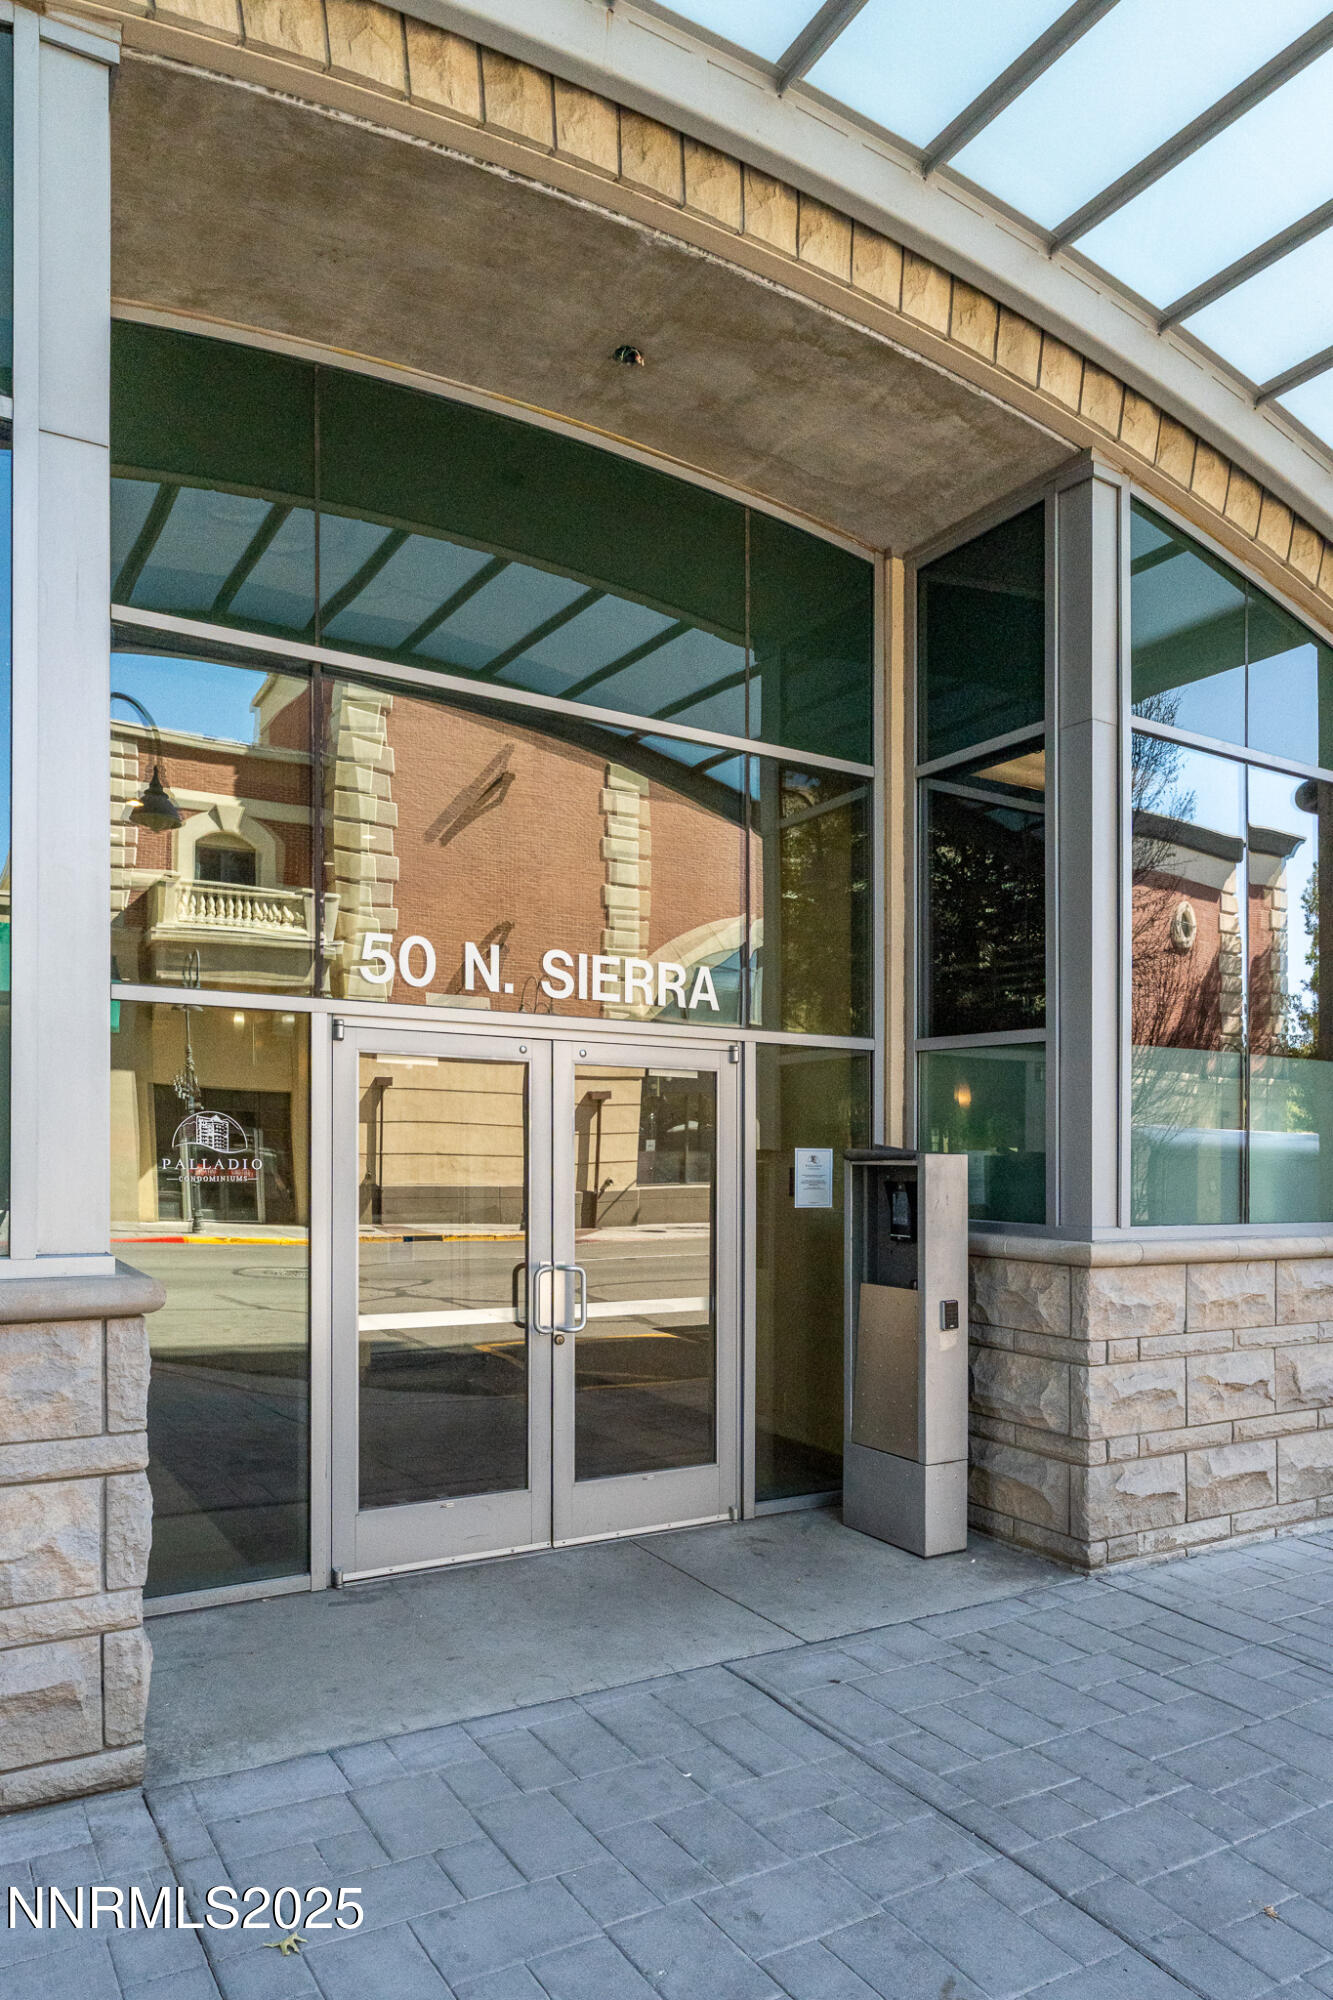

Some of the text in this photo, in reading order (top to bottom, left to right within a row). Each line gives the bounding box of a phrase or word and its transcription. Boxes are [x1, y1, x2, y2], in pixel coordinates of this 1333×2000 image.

[359, 932, 720, 1011] 50 N. SIERRA
[162, 1158, 263, 1171] PALLADIO
[178, 1175, 248, 1183] CONDOMINIUMS
